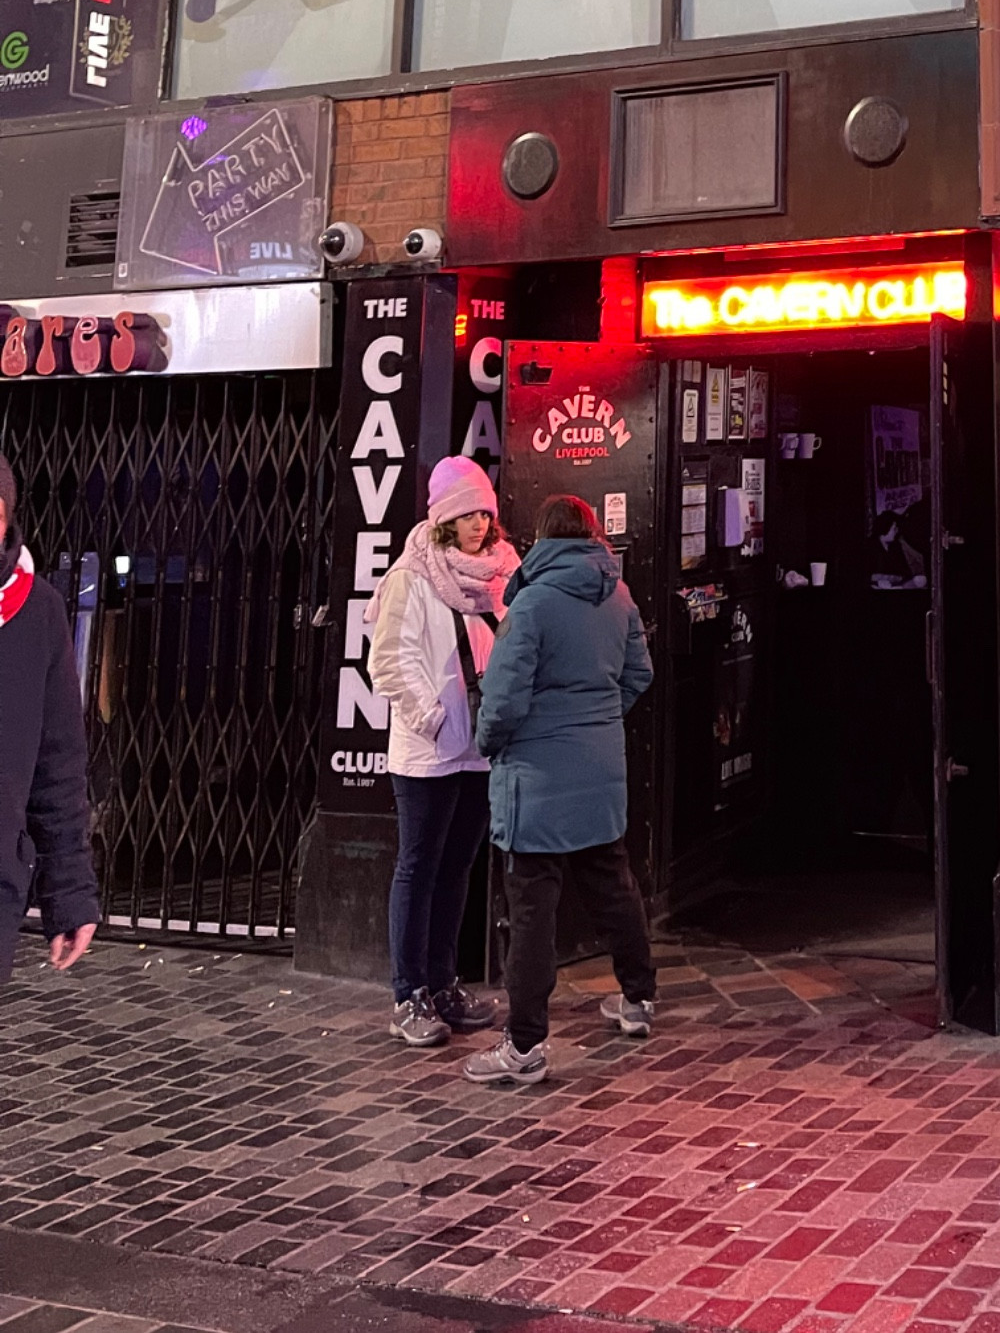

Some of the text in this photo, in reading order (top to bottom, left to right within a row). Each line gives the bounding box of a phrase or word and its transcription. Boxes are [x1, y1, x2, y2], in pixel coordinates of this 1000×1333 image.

[187, 125, 283, 209] PARTY
[200, 163, 291, 232] THIS WAY
[364, 297, 407, 319] THE
[471, 299, 505, 320] THE
[650, 270, 967, 329] The CAVERN CLUB
[532, 394, 632, 453] CAVERN
[561, 427, 606, 444] CLUB
[556, 447, 610, 459] LIVERPOOL
[331, 750, 388, 774] CLUB
